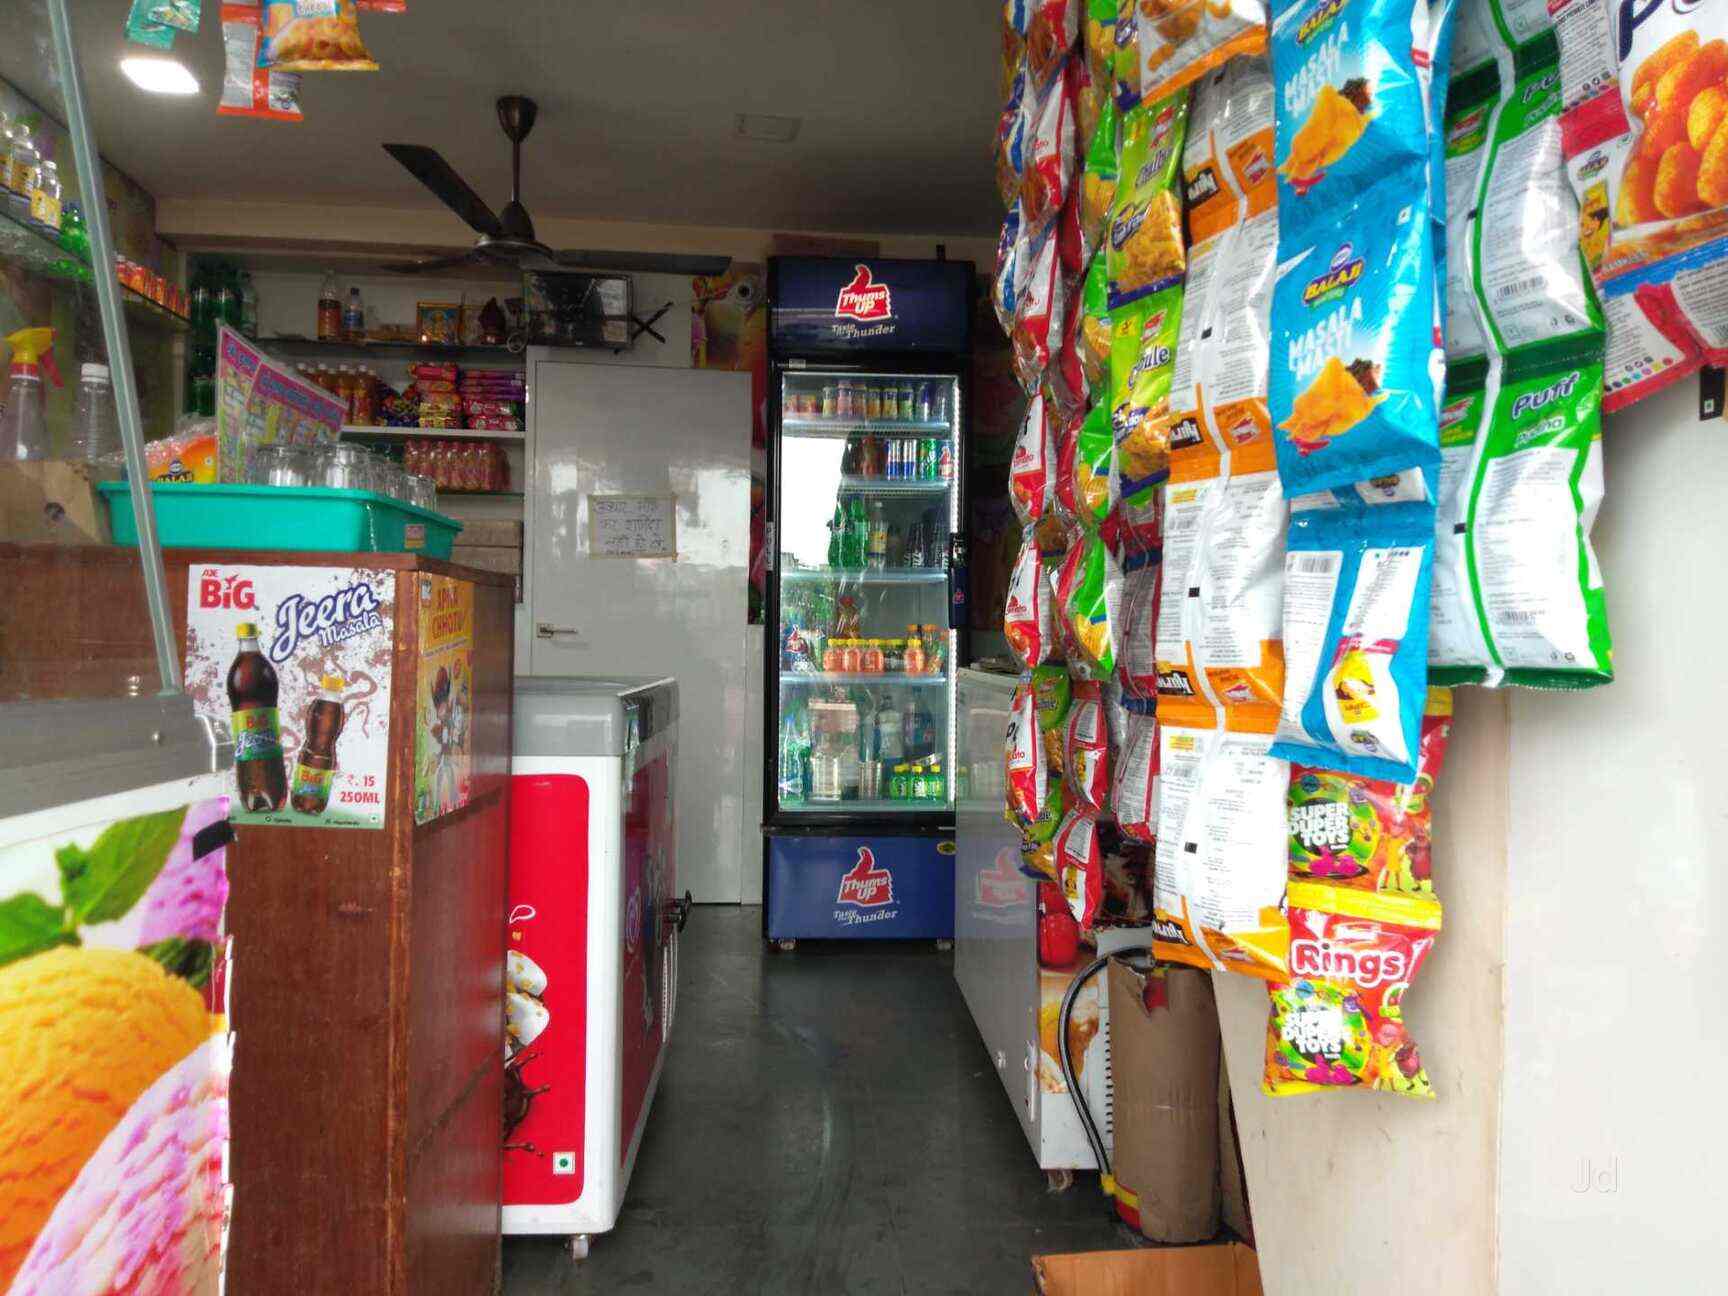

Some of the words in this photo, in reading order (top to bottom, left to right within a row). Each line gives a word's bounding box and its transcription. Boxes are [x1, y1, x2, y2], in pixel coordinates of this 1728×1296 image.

[269, 582, 383, 663] Jeera
[318, 612, 382, 648] Masala
[363, 774, 375, 787] 15
[340, 791, 380, 804] 250ML
[844, 877, 888, 894] Thums
[848, 910, 898, 925] Thunder
[1293, 940, 1404, 986] Rings
